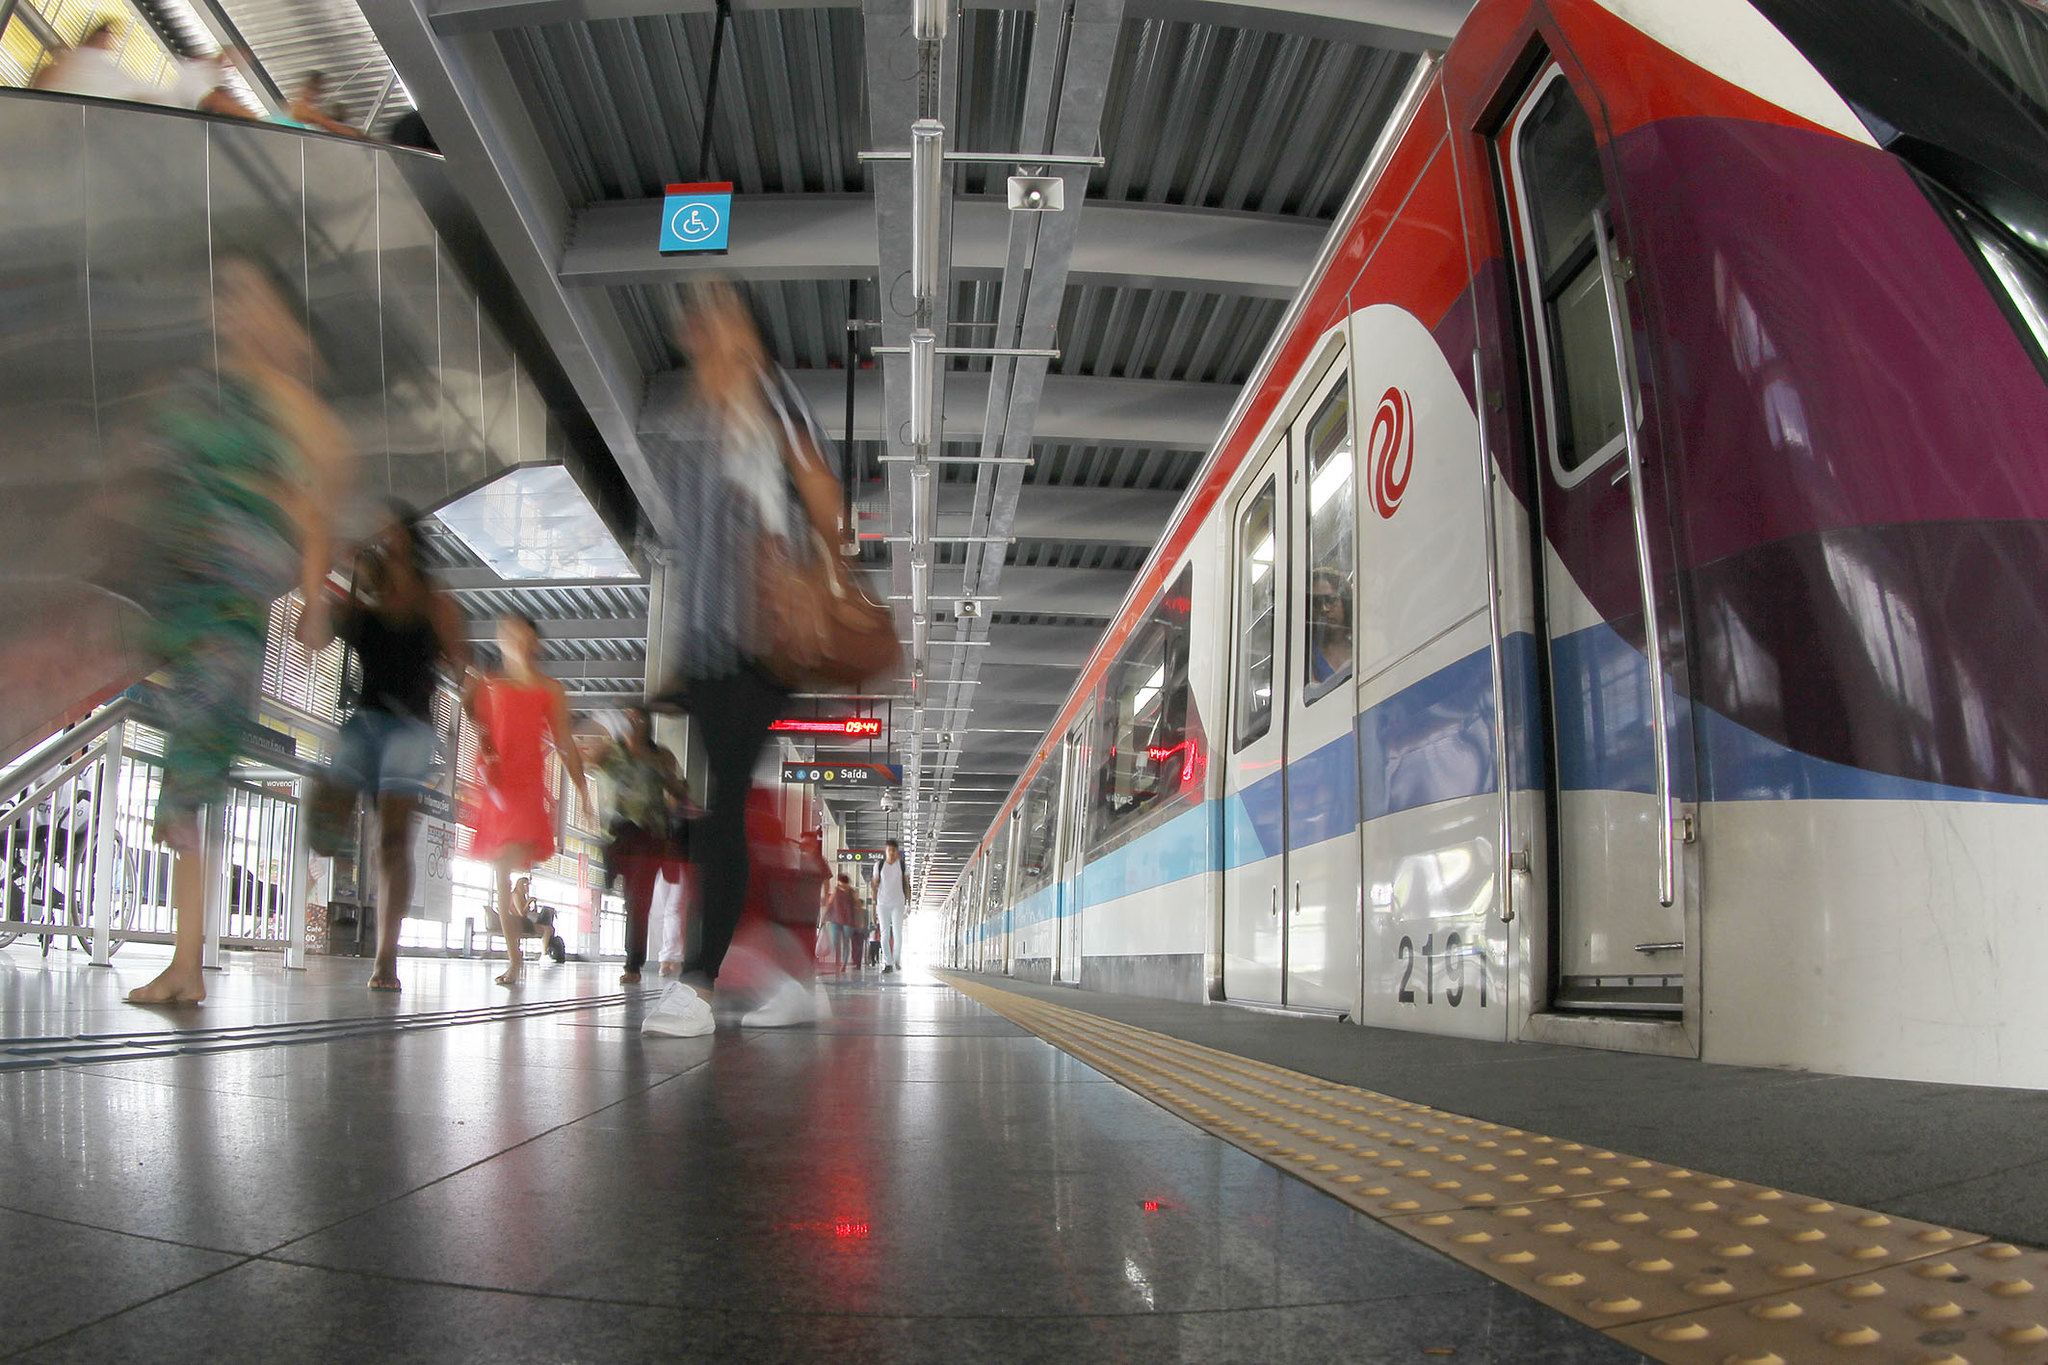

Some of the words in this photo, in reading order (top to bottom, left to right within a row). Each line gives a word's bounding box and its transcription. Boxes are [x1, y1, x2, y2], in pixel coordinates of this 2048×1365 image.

[846, 721, 878, 733] 09:44
[840, 768, 868, 779] Saída
[1398, 931, 1487, 1008] 2191
